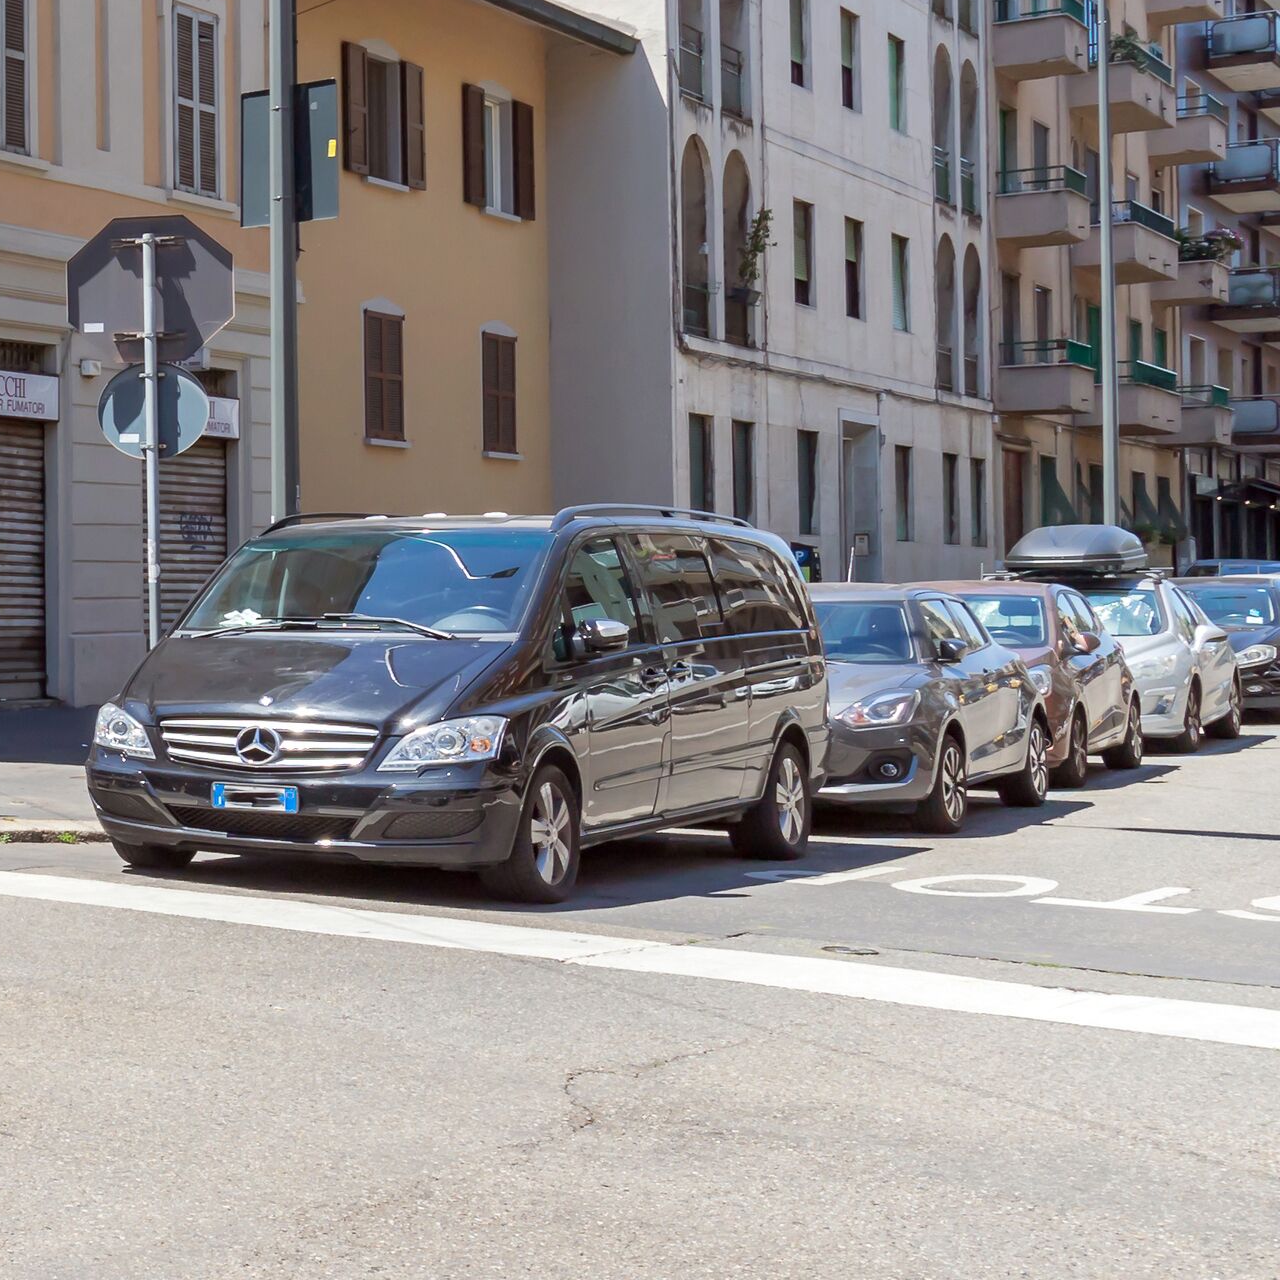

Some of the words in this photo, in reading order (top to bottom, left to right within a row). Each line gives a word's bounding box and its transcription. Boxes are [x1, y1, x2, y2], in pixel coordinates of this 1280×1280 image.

[7, 399, 45, 415] FUMATORI
[205, 421, 231, 434] MATORI
[795, 550, 805, 561] P
